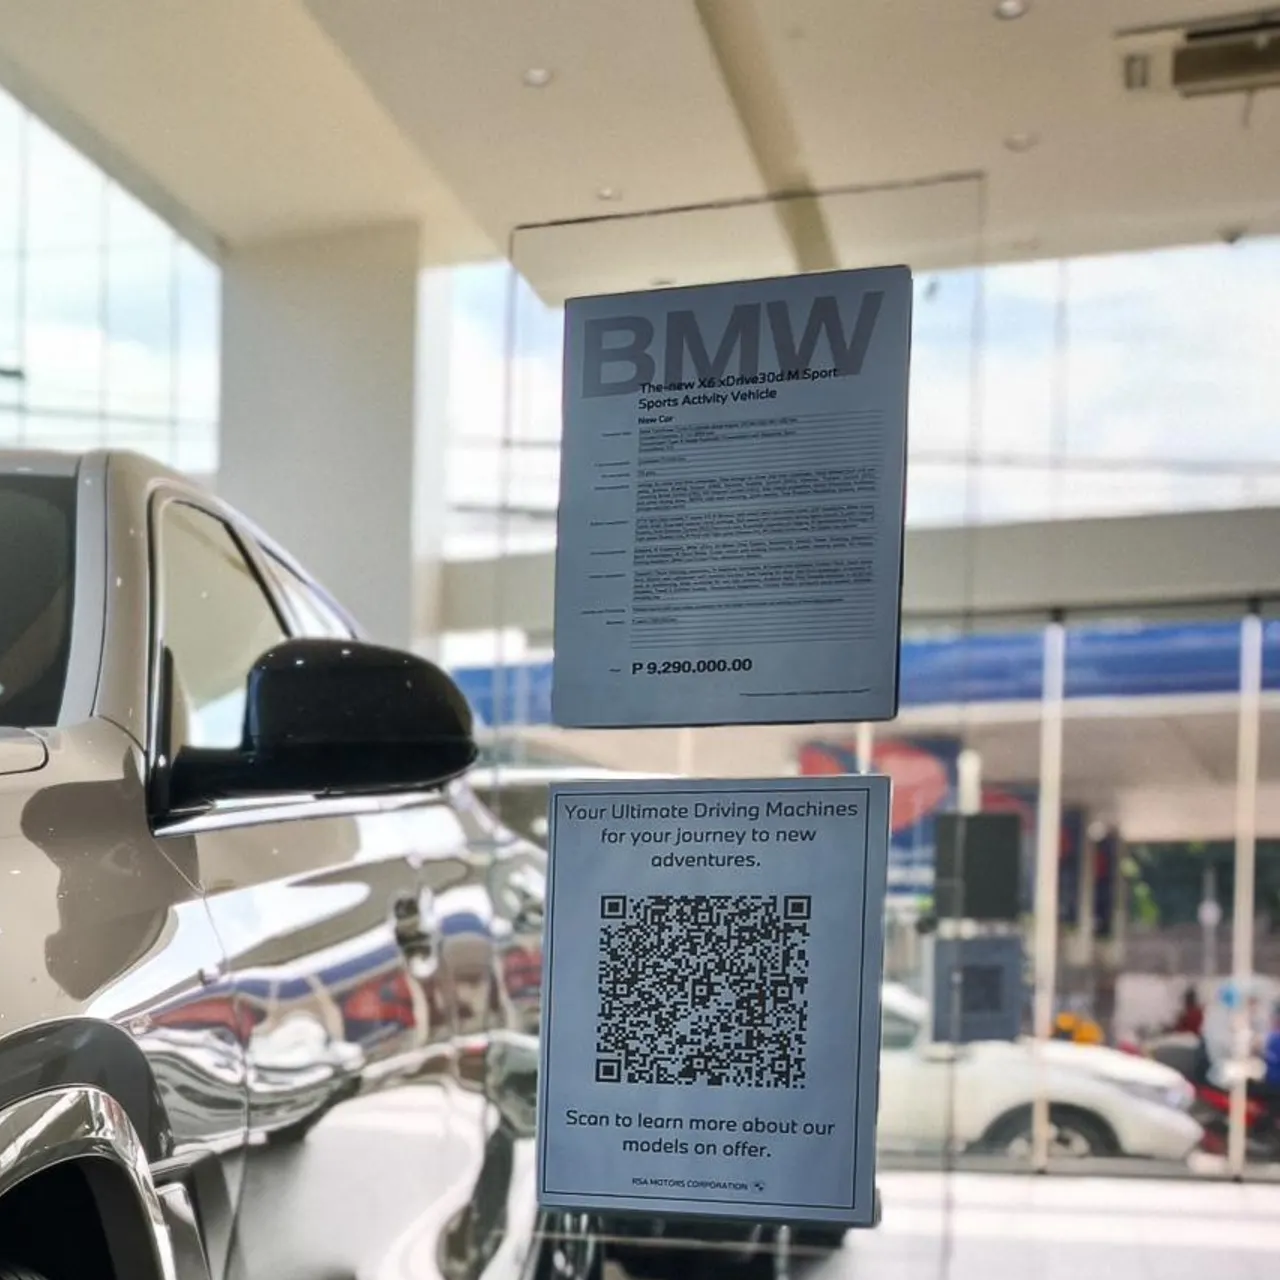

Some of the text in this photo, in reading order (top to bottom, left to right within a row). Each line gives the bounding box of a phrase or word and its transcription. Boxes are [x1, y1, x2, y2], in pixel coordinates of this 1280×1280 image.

[582, 291, 885, 398] BMW
[639, 382, 663, 394] The
[697, 377, 716, 389] X6
[719, 372, 784, 387] xDrive30d
[787, 369, 799, 381] M
[803, 367, 837, 381] Sport
[638, 388, 777, 411] Sports Activity Vehicle
[632, 661, 643, 675] P
[564, 801, 858, 821] Your Ultimate Driving Machines
[601, 827, 817, 847] for your journey to new
[651, 852, 761, 868] adventures.
[566, 1109, 836, 1136] Scan to learn more about our
[622, 1138, 772, 1158] models on offer.
[650, 1178, 685, 1188] MOTORS
[686, 1179, 748, 1190] CORPORATION
